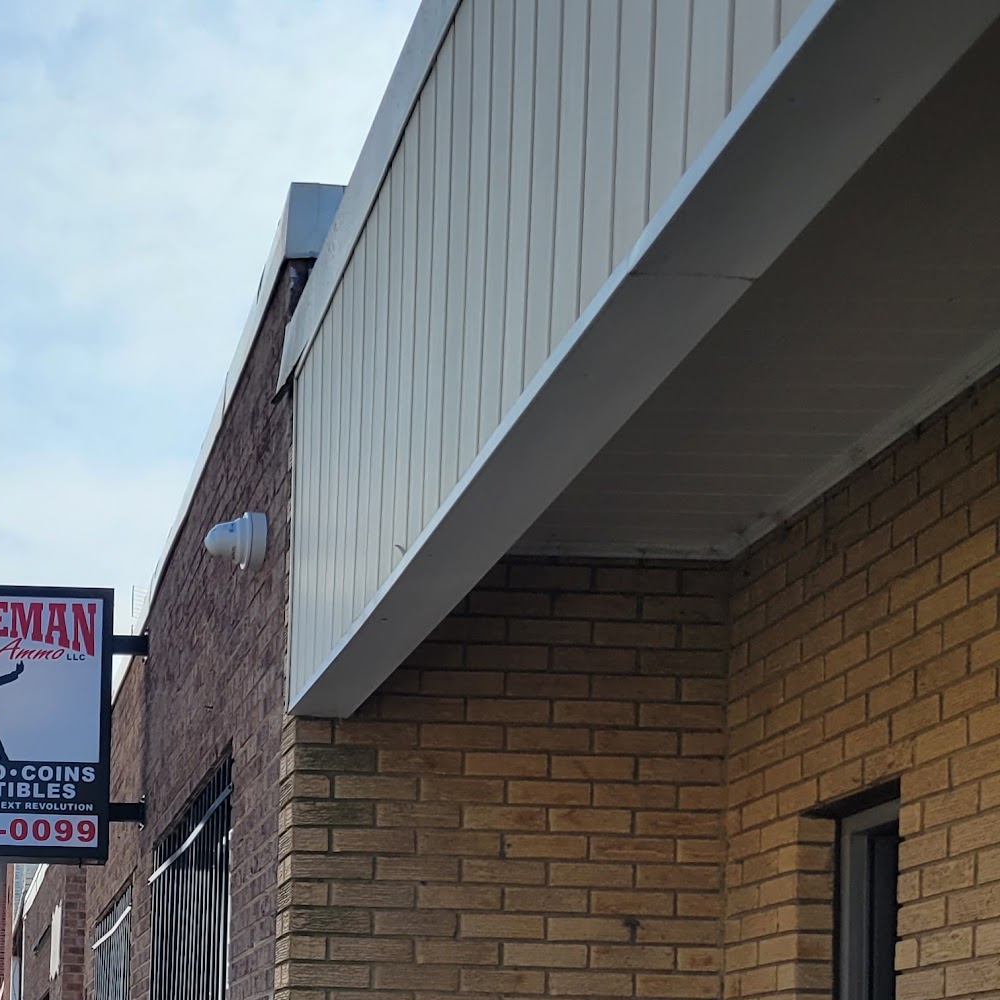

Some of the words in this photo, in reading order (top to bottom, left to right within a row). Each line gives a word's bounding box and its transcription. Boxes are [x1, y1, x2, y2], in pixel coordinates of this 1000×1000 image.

[66, 653, 86, 661] LLC
[21, 765, 96, 783] COINS
[25, 802, 94, 812] REVOLUTION
